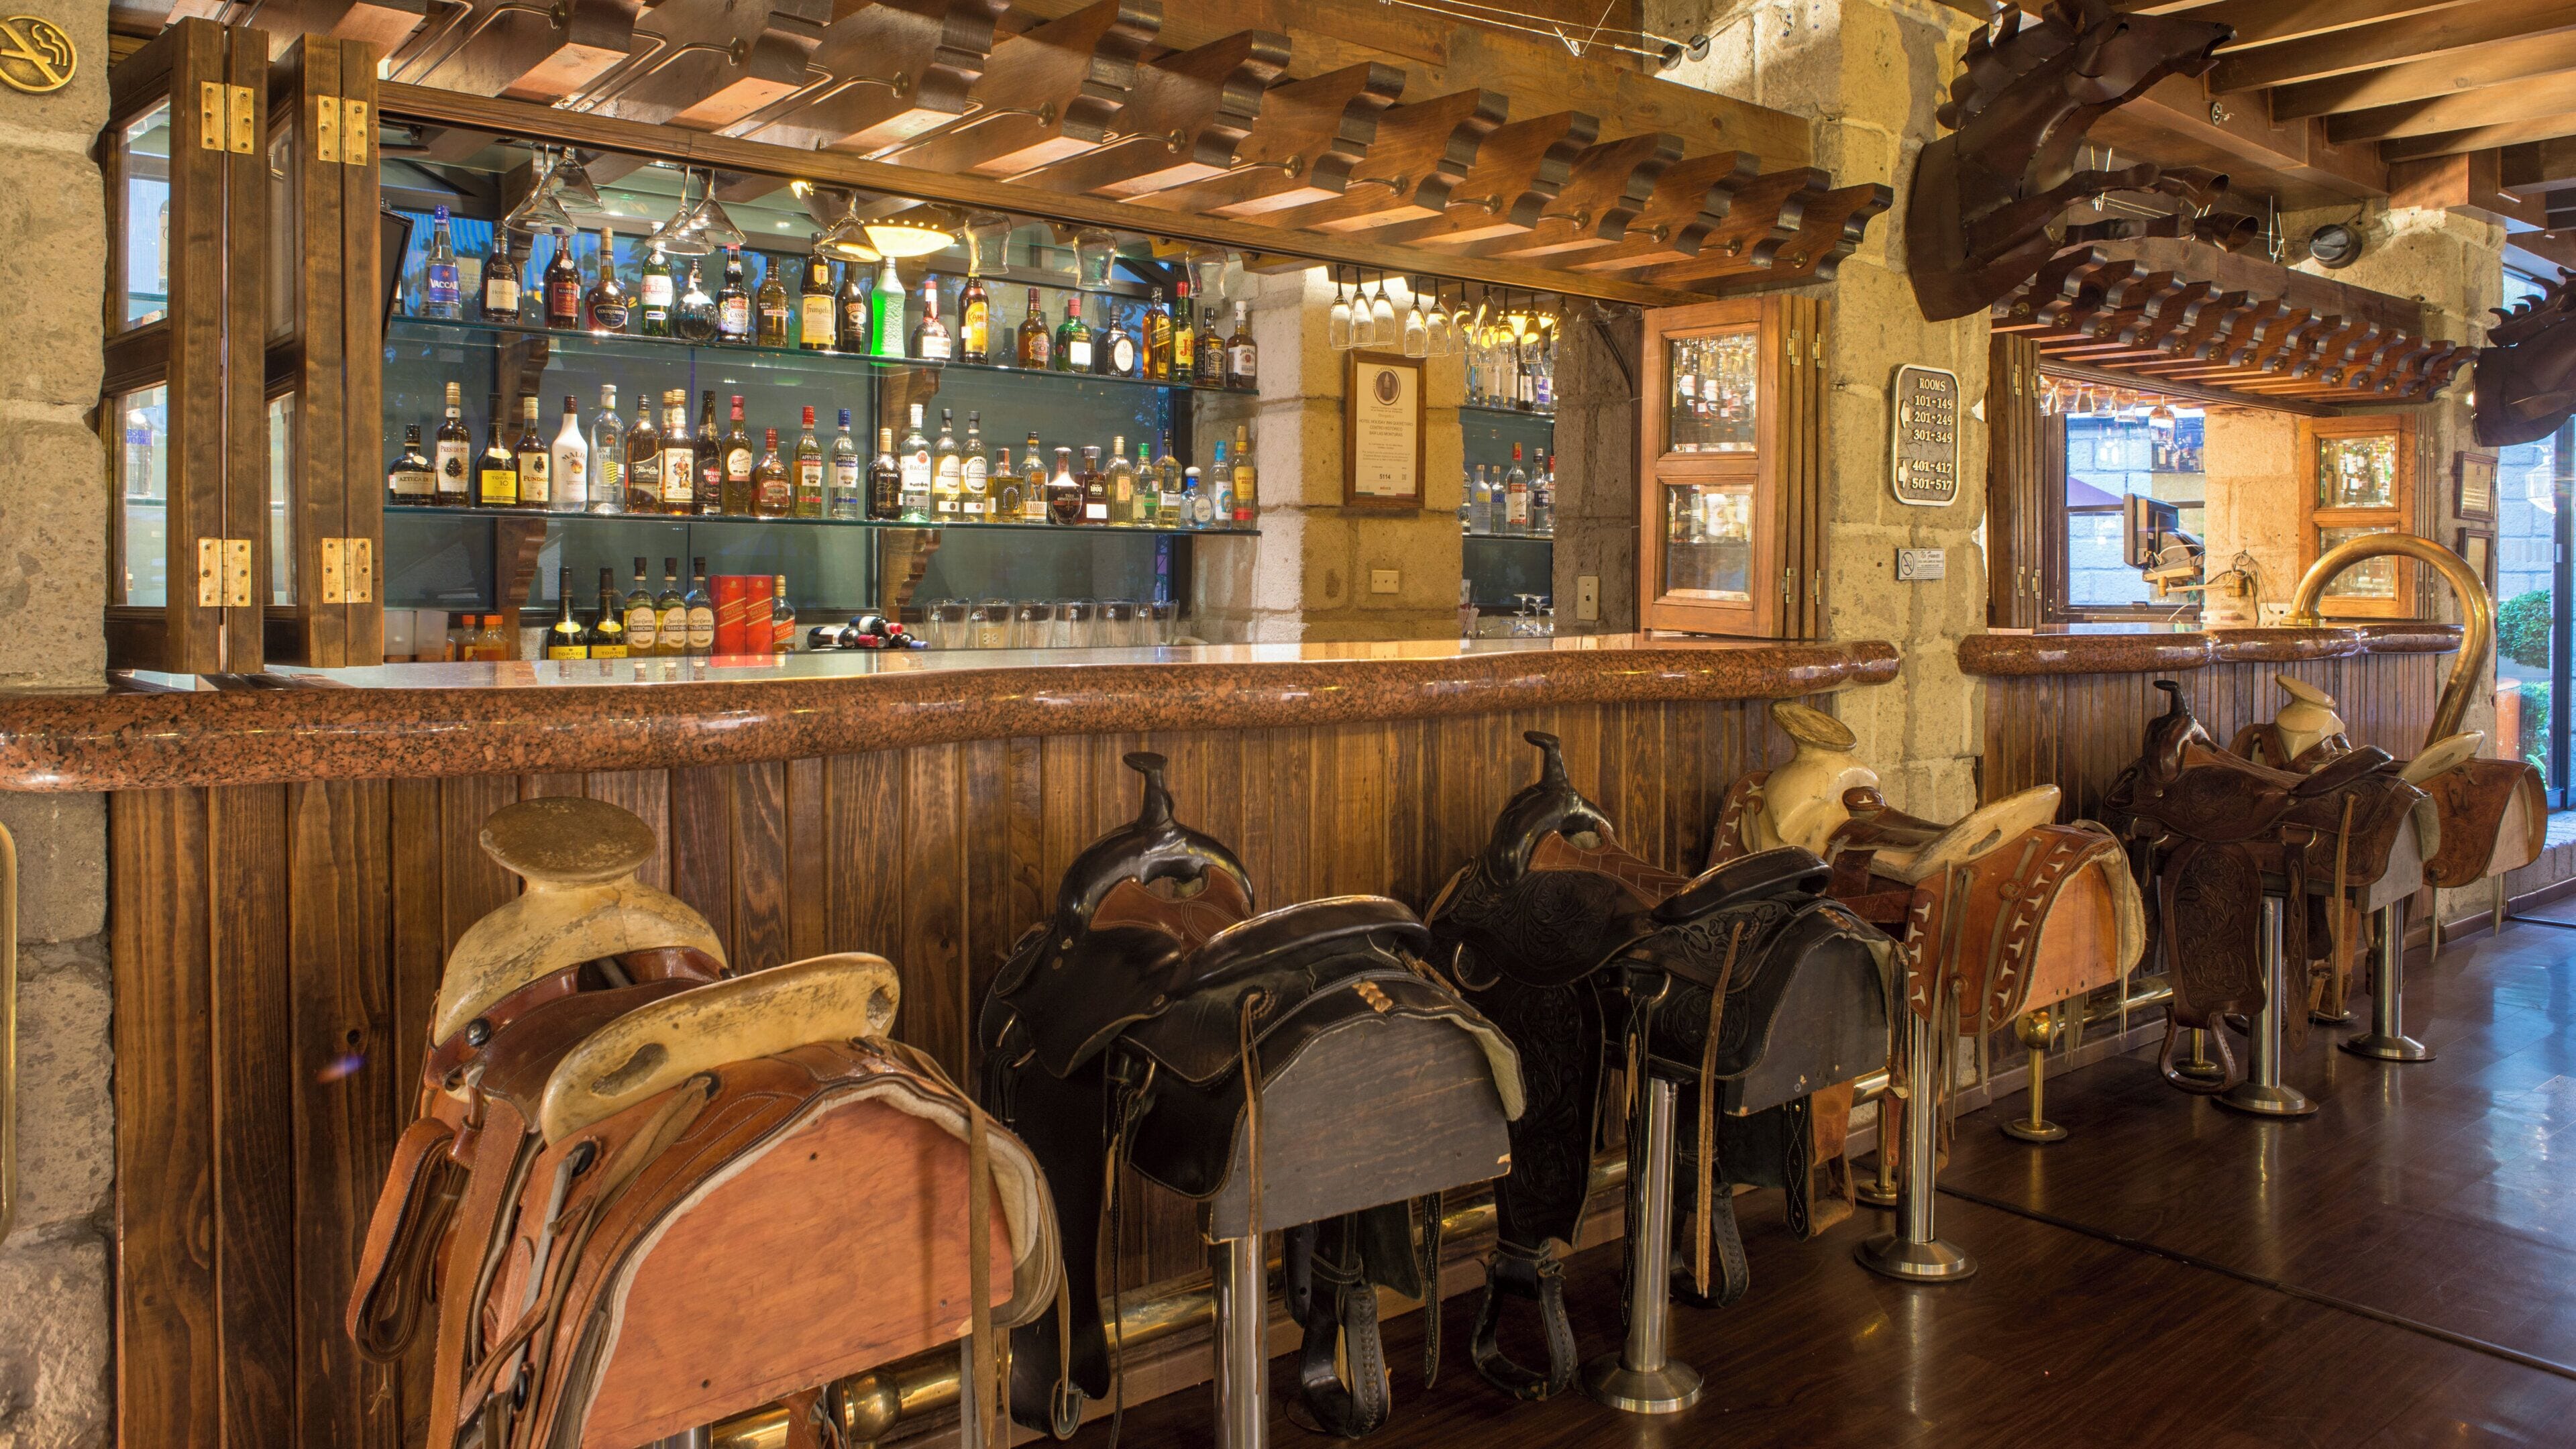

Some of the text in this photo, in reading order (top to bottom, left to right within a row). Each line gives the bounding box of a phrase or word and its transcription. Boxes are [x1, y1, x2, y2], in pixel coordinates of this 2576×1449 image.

[1919, 378, 1946, 392] ROOMS
[1914, 394, 1953, 409] 101-149
[1914, 411, 1953, 425] 201-249
[1913, 429, 1953, 443] 301-349
[1912, 460, 1952, 474] 401-417
[1912, 477, 1952, 491] 501-517
[732, 605, 744, 614] Label
